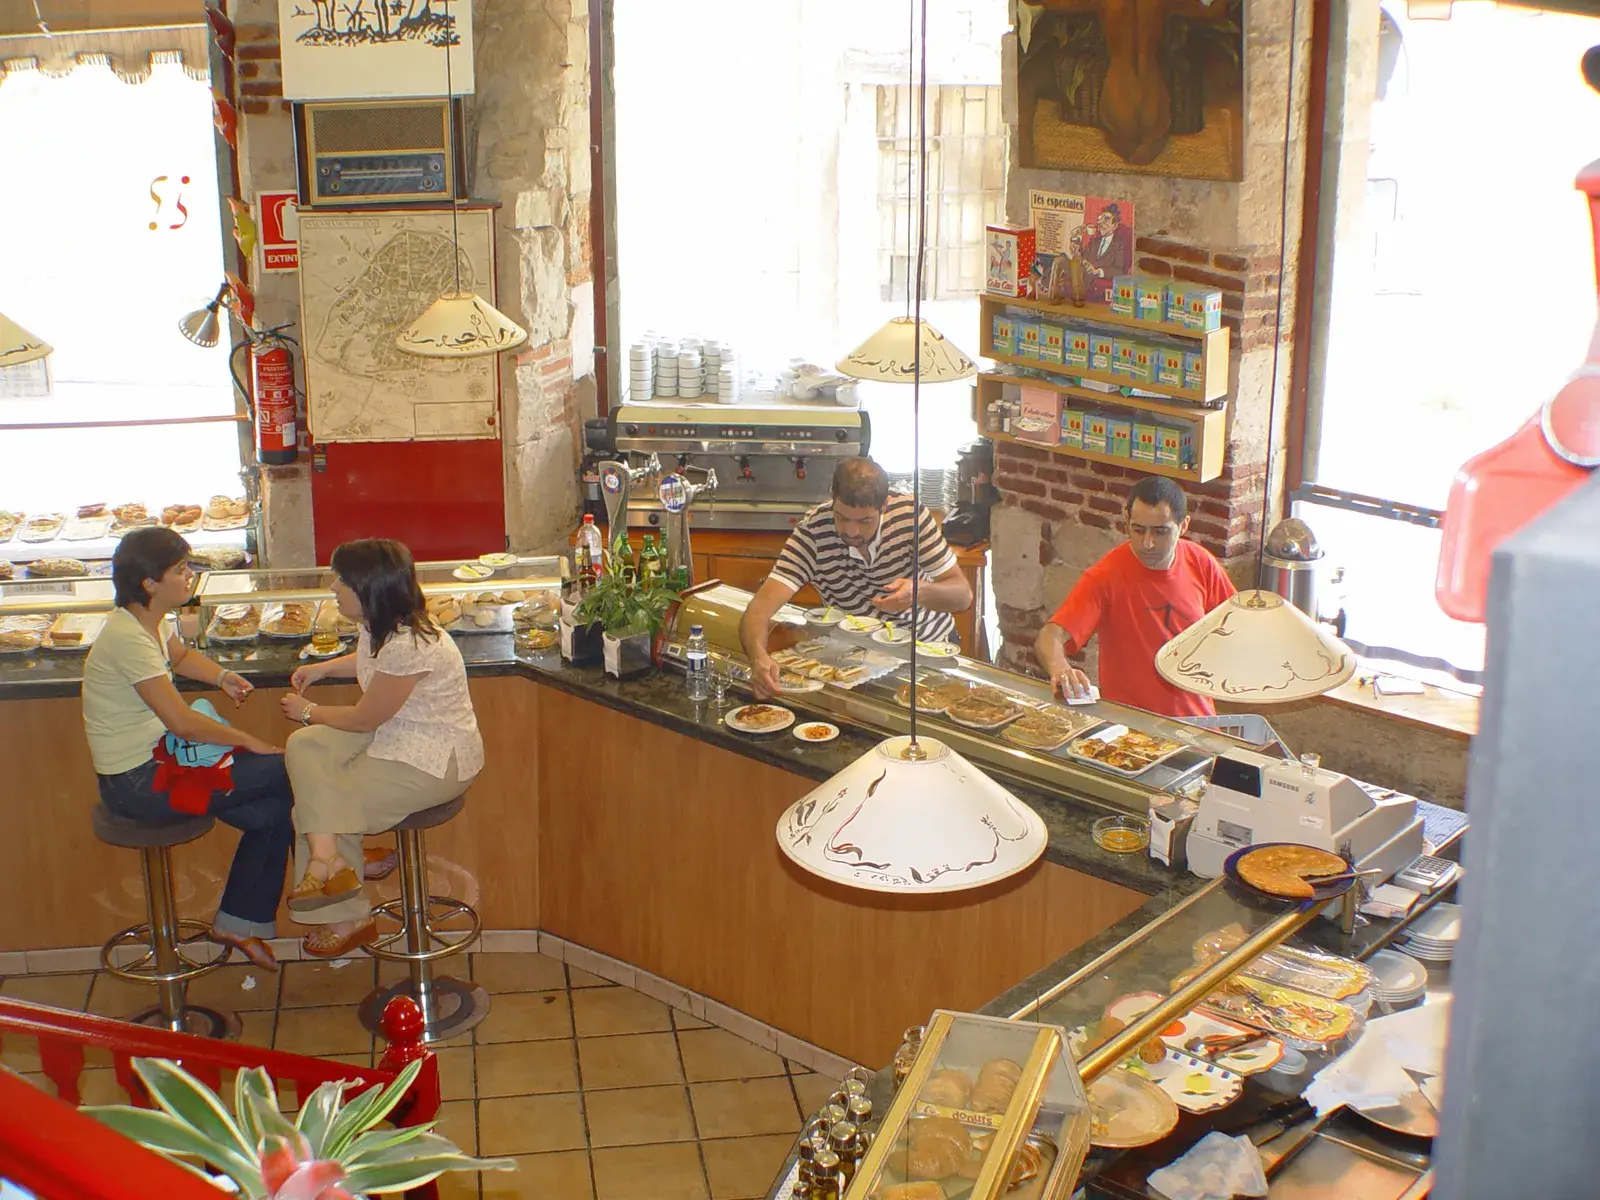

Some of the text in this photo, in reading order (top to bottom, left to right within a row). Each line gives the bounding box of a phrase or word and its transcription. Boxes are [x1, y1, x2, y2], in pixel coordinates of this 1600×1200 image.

[1046, 196, 1084, 211] especiales
[987, 278, 1001, 289] Cola
[1001, 280, 1014, 291] Cao
[1268, 778, 1300, 793] SAMSUNG
[951, 1110, 993, 1126] donuts
